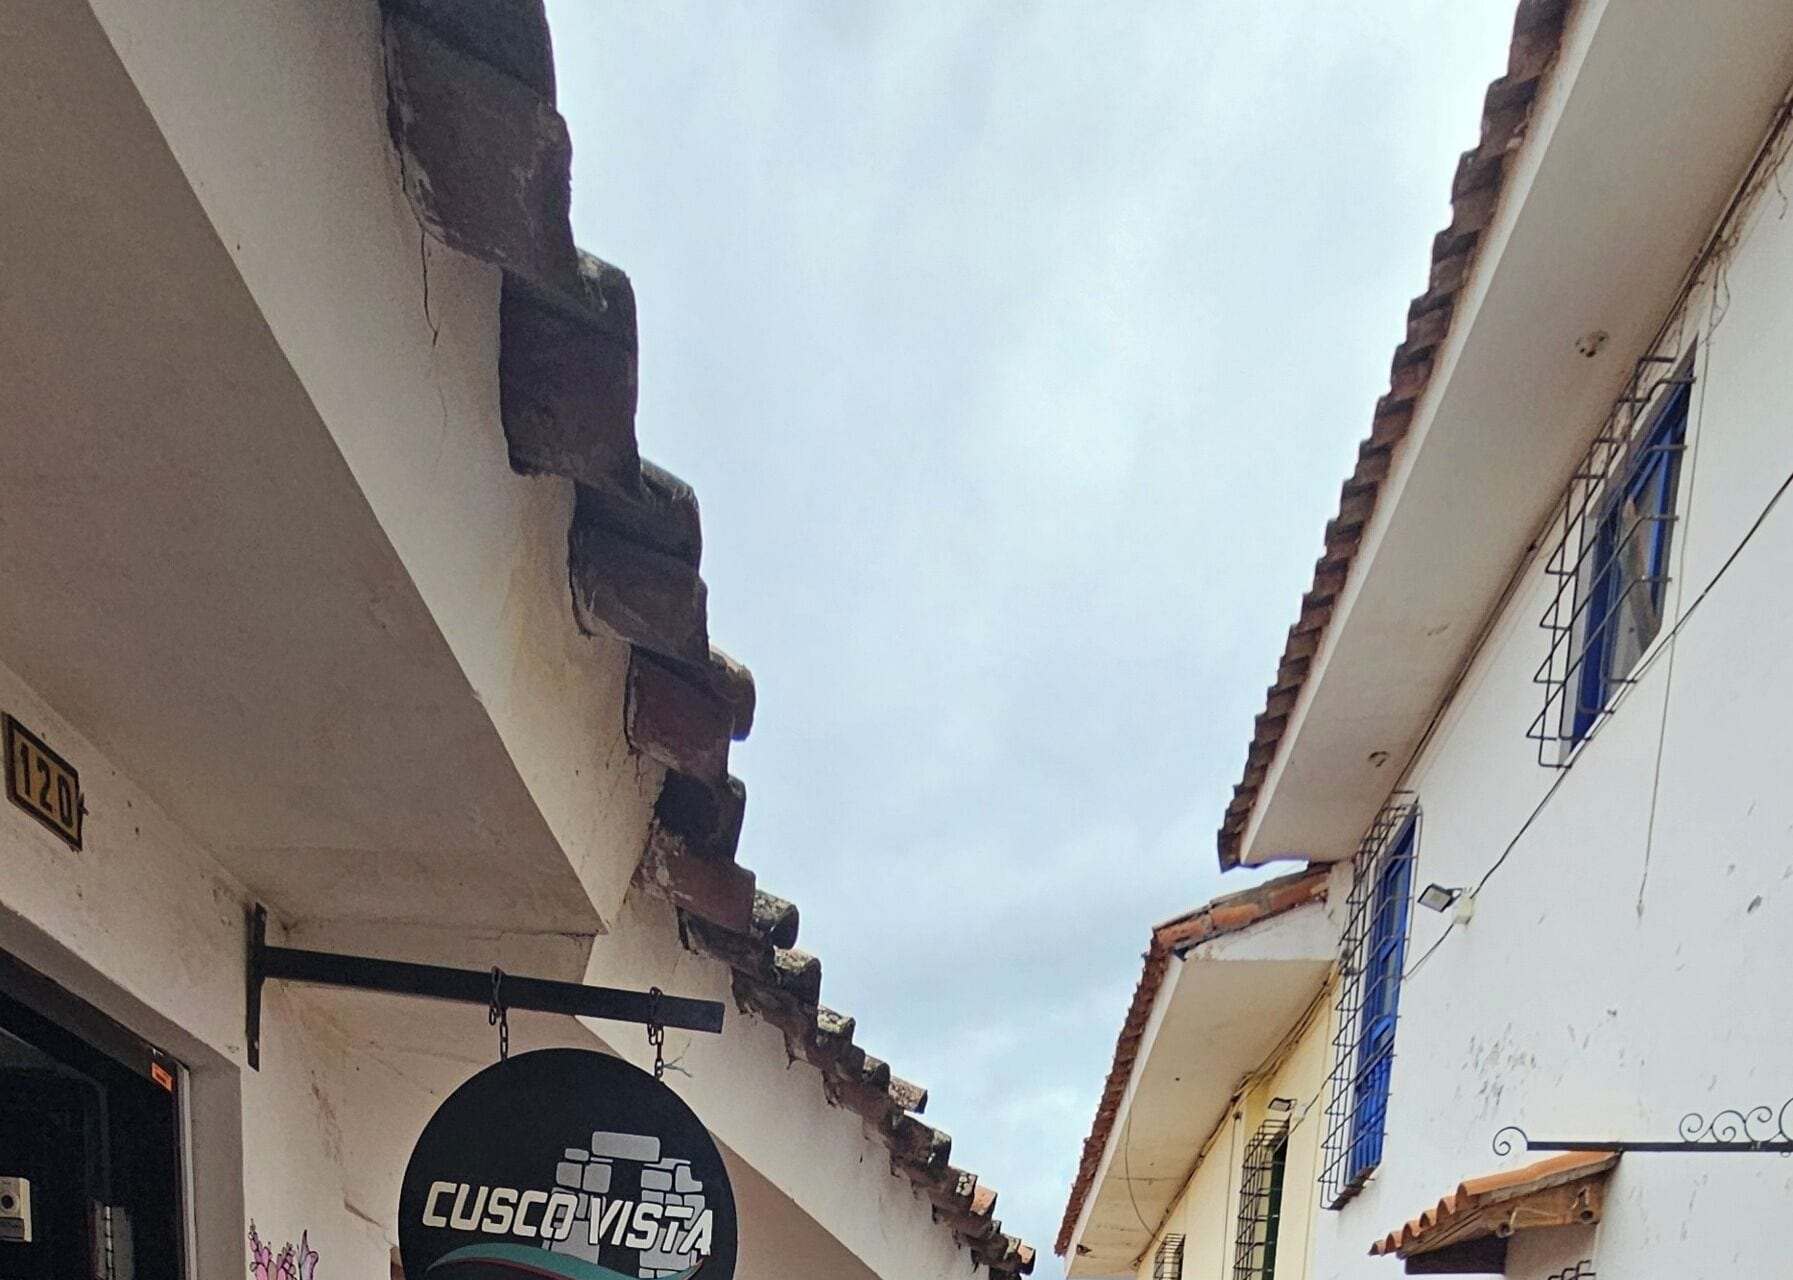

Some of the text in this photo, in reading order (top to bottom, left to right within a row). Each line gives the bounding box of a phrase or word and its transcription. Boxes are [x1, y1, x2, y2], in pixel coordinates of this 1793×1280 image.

[20, 742, 73, 829] 120
[422, 1181, 713, 1255] CUSCO VISTA
